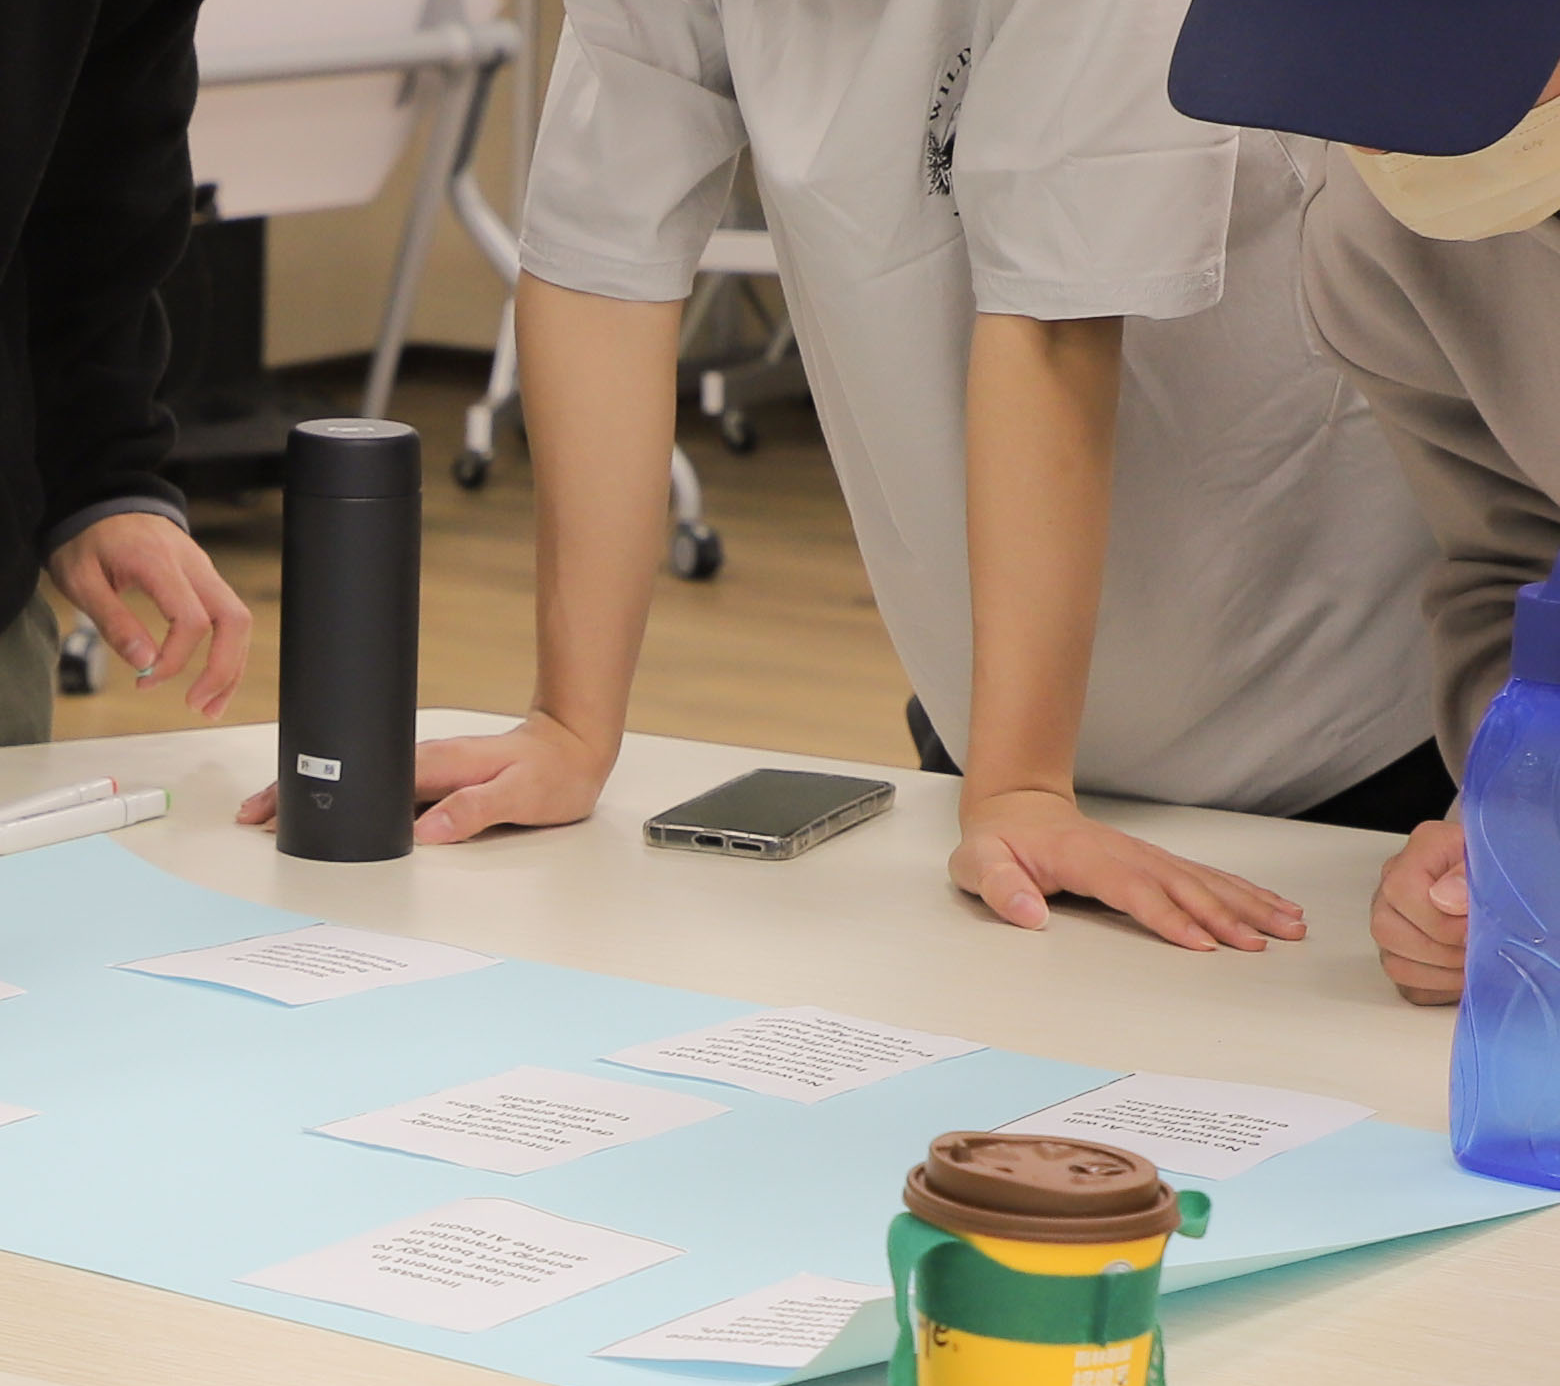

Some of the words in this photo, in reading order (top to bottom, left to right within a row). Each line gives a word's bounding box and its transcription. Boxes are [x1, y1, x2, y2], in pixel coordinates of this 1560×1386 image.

[446, 1100, 497, 1114] aligns
[498, 1094, 547, 1105] goals
[496, 1102, 556, 1116] energy
[545, 1102, 630, 1122] transition
[1115, 1104, 1147, 1113] the
[419, 1112, 516, 1134] regulations
[481, 1117, 542, 1130] ensure
[497, 1111, 614, 1136] development
[558, 1113, 597, 1123] with
[1063, 1117, 1098, 1126] will
[1072, 1111, 1153, 1128] increase
[1095, 1108, 1191, 1126] efficiency
[1150, 1110, 1228, 1125] support
[1223, 1114, 1289, 1128] energy
[1195, 1124, 1262, 1139] energy
[1229, 1122, 1269, 1132] and
[467, 1131, 554, 1152] Introduce
[517, 1132, 571, 1145] aware
[1156, 1125, 1260, 1146] eventually
[1214, 1143, 1242, 1152] No
[430, 1222, 487, 1237] boom
[391, 1237, 425, 1246] the
[409, 1229, 503, 1253] transition
[486, 1233, 512, 1243] AI
[372, 1244, 394, 1252] to
[396, 1246, 463, 1264] energy
[428, 1241, 475, 1257] both
[512, 1241, 546, 1254] the
[371, 1253, 393, 1262] in
[504, 1251, 573, 1269] energy
[546, 1250, 589, 1262] and
[393, 1257, 504, 1287] investment
[476, 1254, 556, 1276] support
[378, 1266, 462, 1289] Increase
[464, 1263, 541, 1283] nuclear
